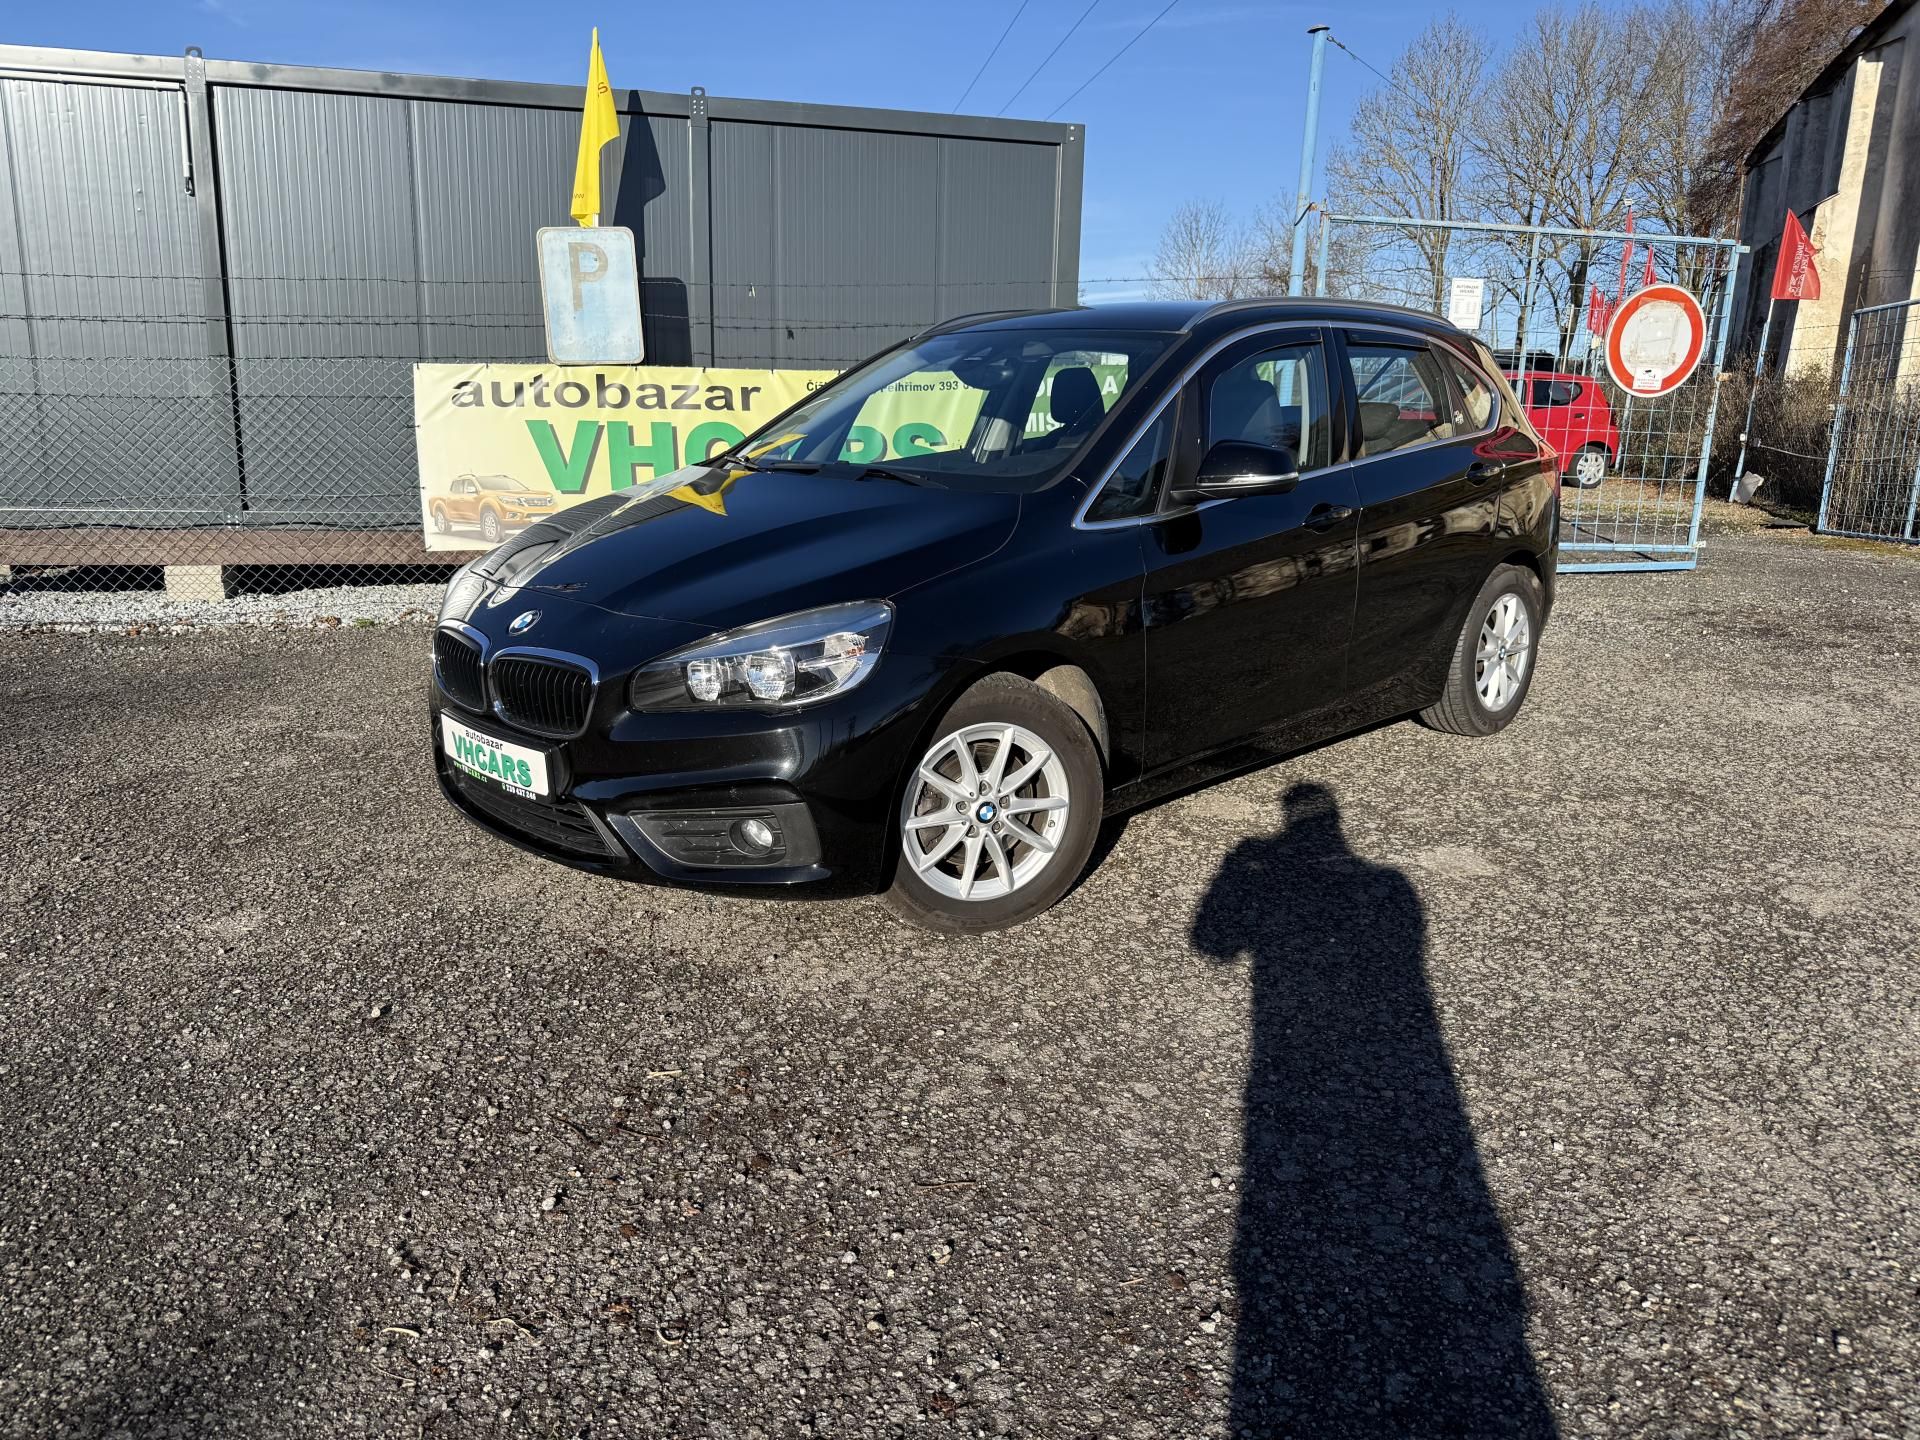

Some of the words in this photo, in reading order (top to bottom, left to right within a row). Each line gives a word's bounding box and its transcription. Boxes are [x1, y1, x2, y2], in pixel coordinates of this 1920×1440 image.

[568, 242, 609, 312] P
[451, 374, 762, 411] autobazar
[939, 380, 959, 391] 393
[465, 728, 504, 751] autobazar
[452, 731, 533, 788] VHCARS
